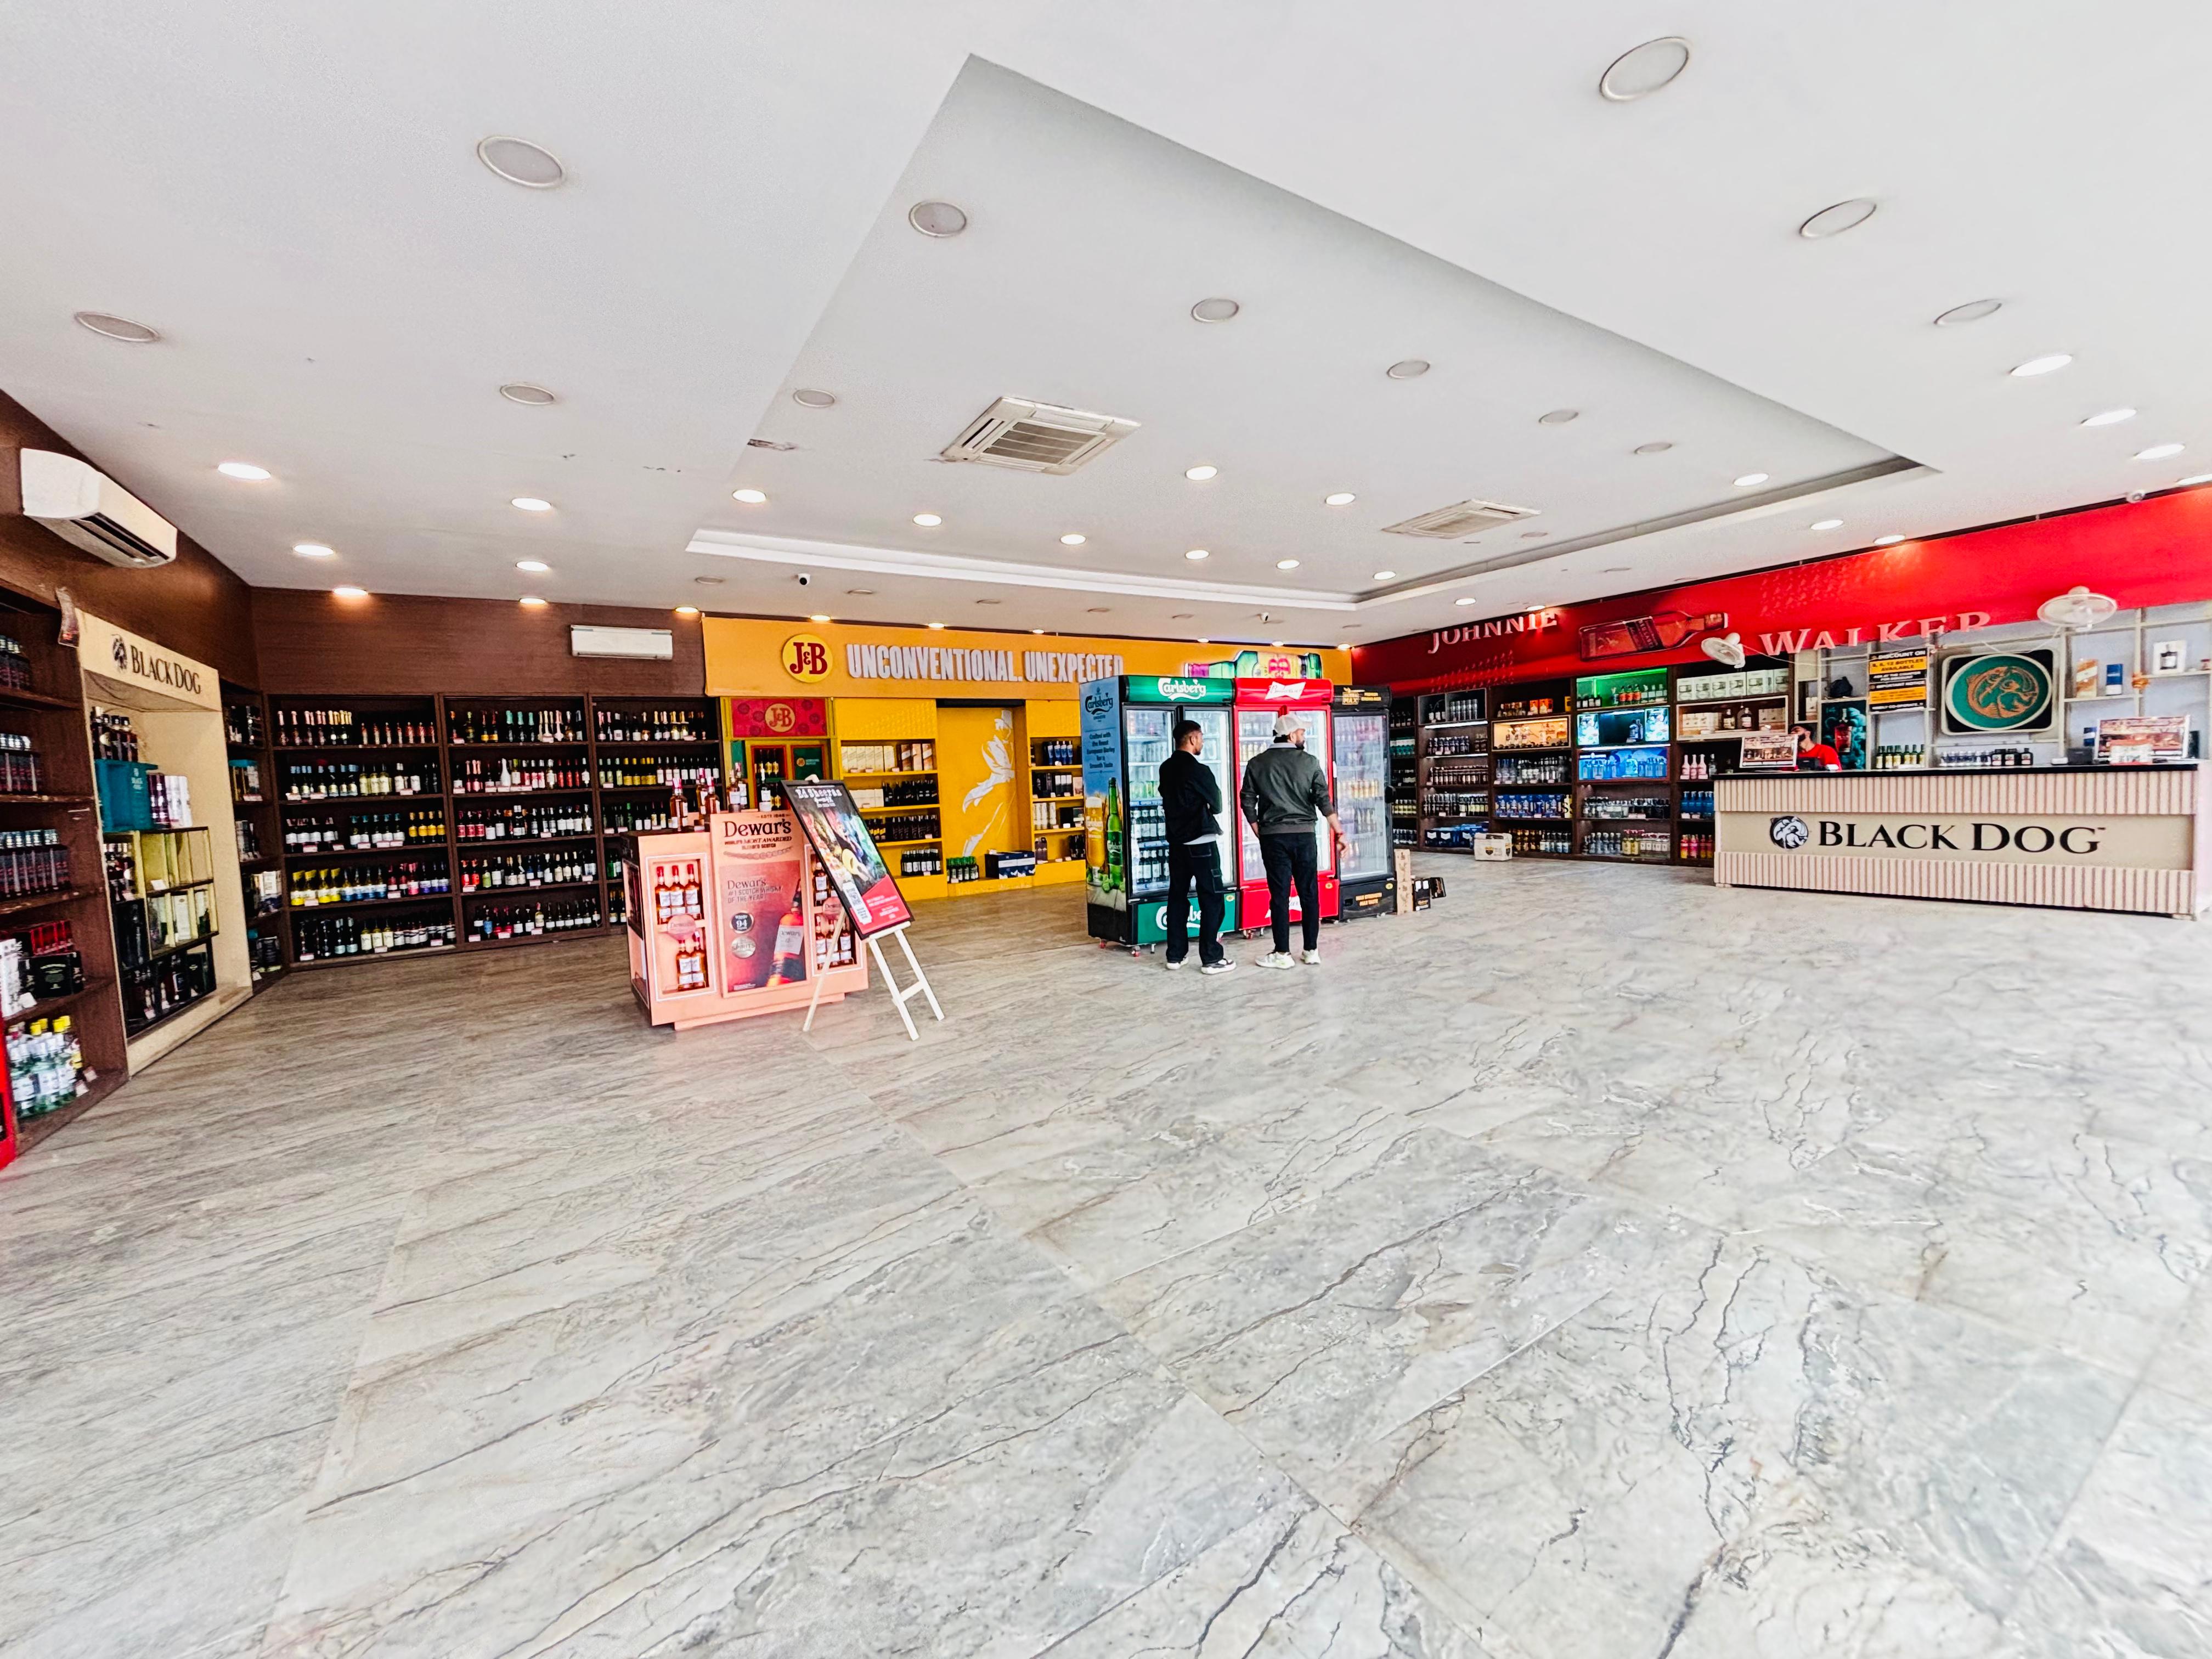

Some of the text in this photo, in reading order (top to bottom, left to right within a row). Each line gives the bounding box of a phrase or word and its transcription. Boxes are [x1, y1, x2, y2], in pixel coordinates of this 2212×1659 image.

[1427, 612, 1557, 654] JOHNNIE
[789, 641, 828, 675] J&B
[846, 644, 1024, 681] UNCONVENTIONAL.
[1878, 651, 1914, 659] DISCOUNT
[130, 645, 201, 695] BLACK DOG
[1158, 678, 1206, 701] Carlsberg
[1085, 692, 1113, 715] Carlsberg
[769, 708, 793, 727] J&B
[807, 788, 842, 798] Sheeran
[723, 819, 792, 838] Dewar's
[1818, 821, 2101, 854] BLACK DOG
[727, 877, 767, 890] Dewar's
[738, 888, 759, 896] SCOTCH
[759, 885, 782, 894] WHISKY
[736, 919, 748, 928] 94
